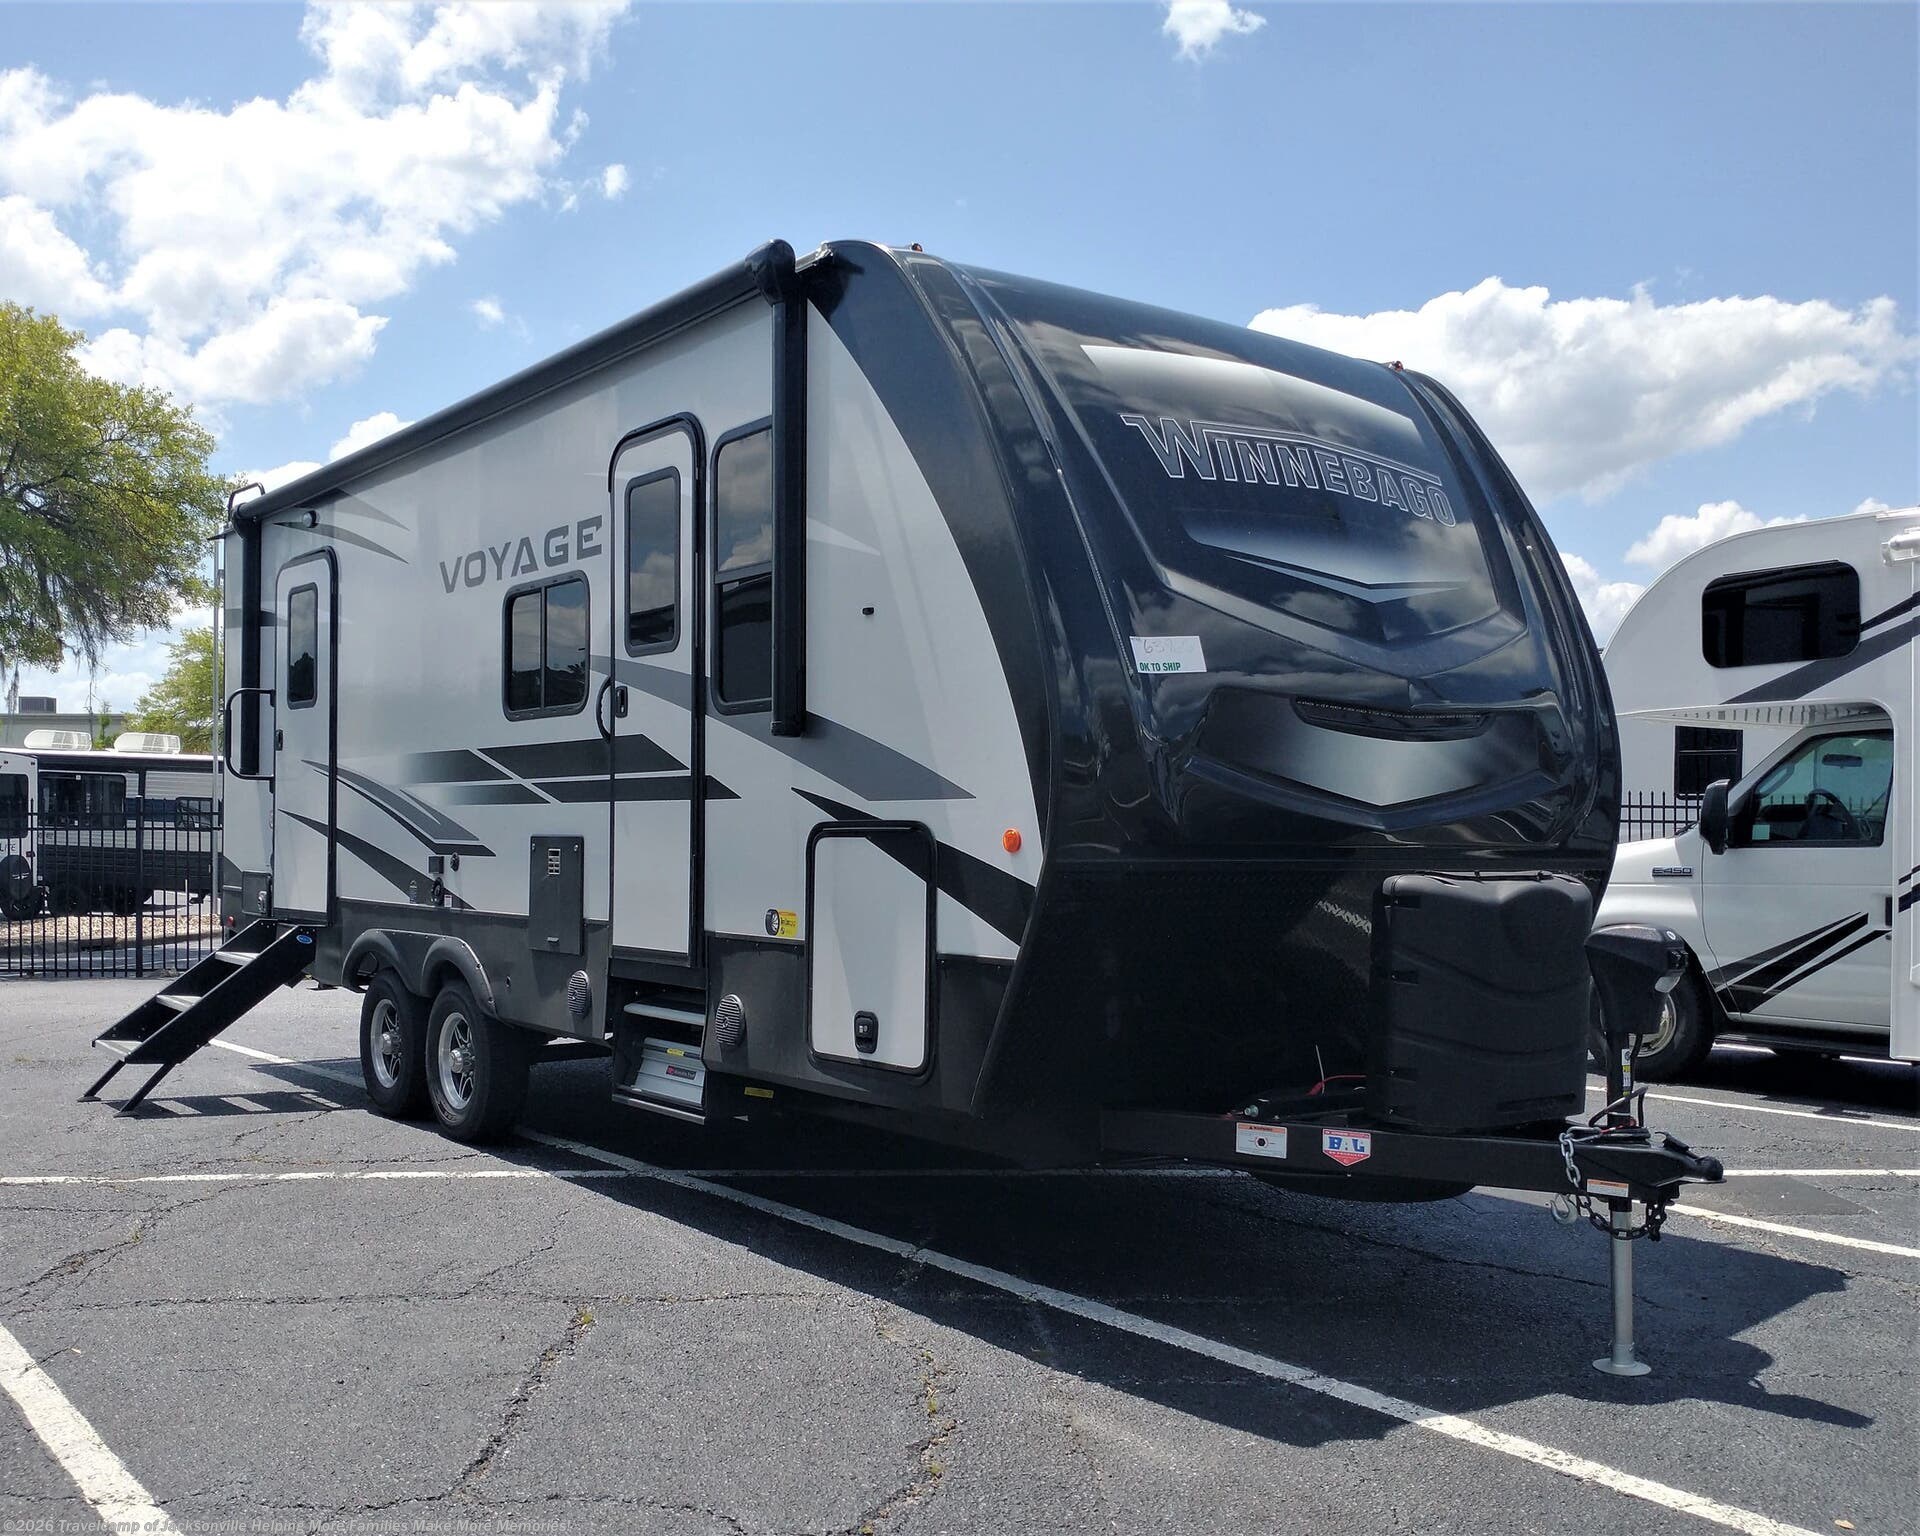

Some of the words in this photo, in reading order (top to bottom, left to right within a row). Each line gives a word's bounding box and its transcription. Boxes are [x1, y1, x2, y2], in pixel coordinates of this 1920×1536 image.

[1120, 414, 1456, 527] WINNEBAGO
[439, 514, 603, 594] VOYAGE
[1139, 662, 1150, 671] OK
[1150, 662, 1161, 671] TO
[1163, 662, 1181, 671] SHIP
[1652, 867, 1692, 875] E450
